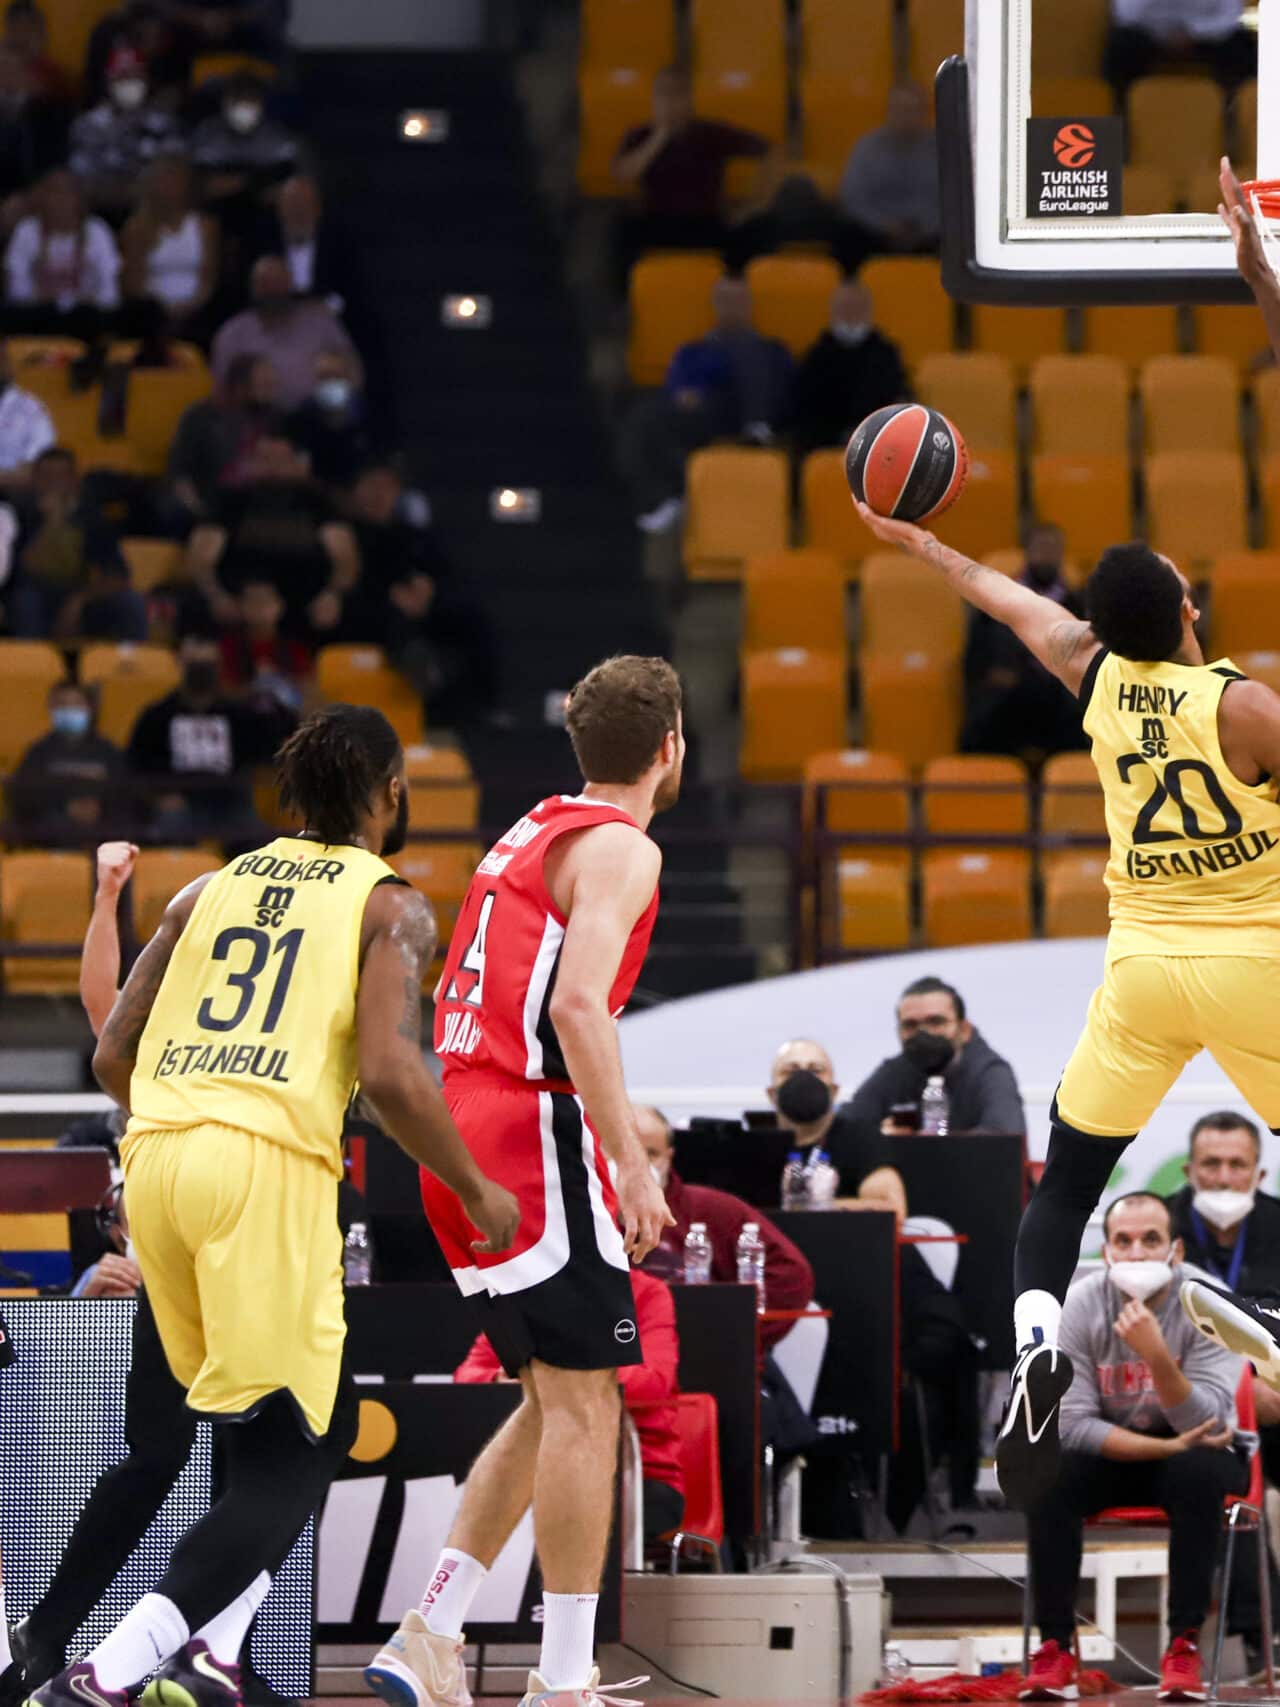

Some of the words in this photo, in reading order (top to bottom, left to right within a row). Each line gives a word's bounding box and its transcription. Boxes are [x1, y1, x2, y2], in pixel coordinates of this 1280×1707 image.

[1041, 170, 1108, 184] TURKISH
[1041, 185, 1108, 199] AIRLINES
[1039, 199, 1109, 214] EuroLeague
[1118, 683, 1188, 717] HENRY
[1116, 753, 1243, 845] 20
[233, 854, 345, 884] BOOKER
[197, 927, 305, 1034] 31
[817, 1415, 859, 1435] 21+
[424, 1569, 451, 1605] GSA
